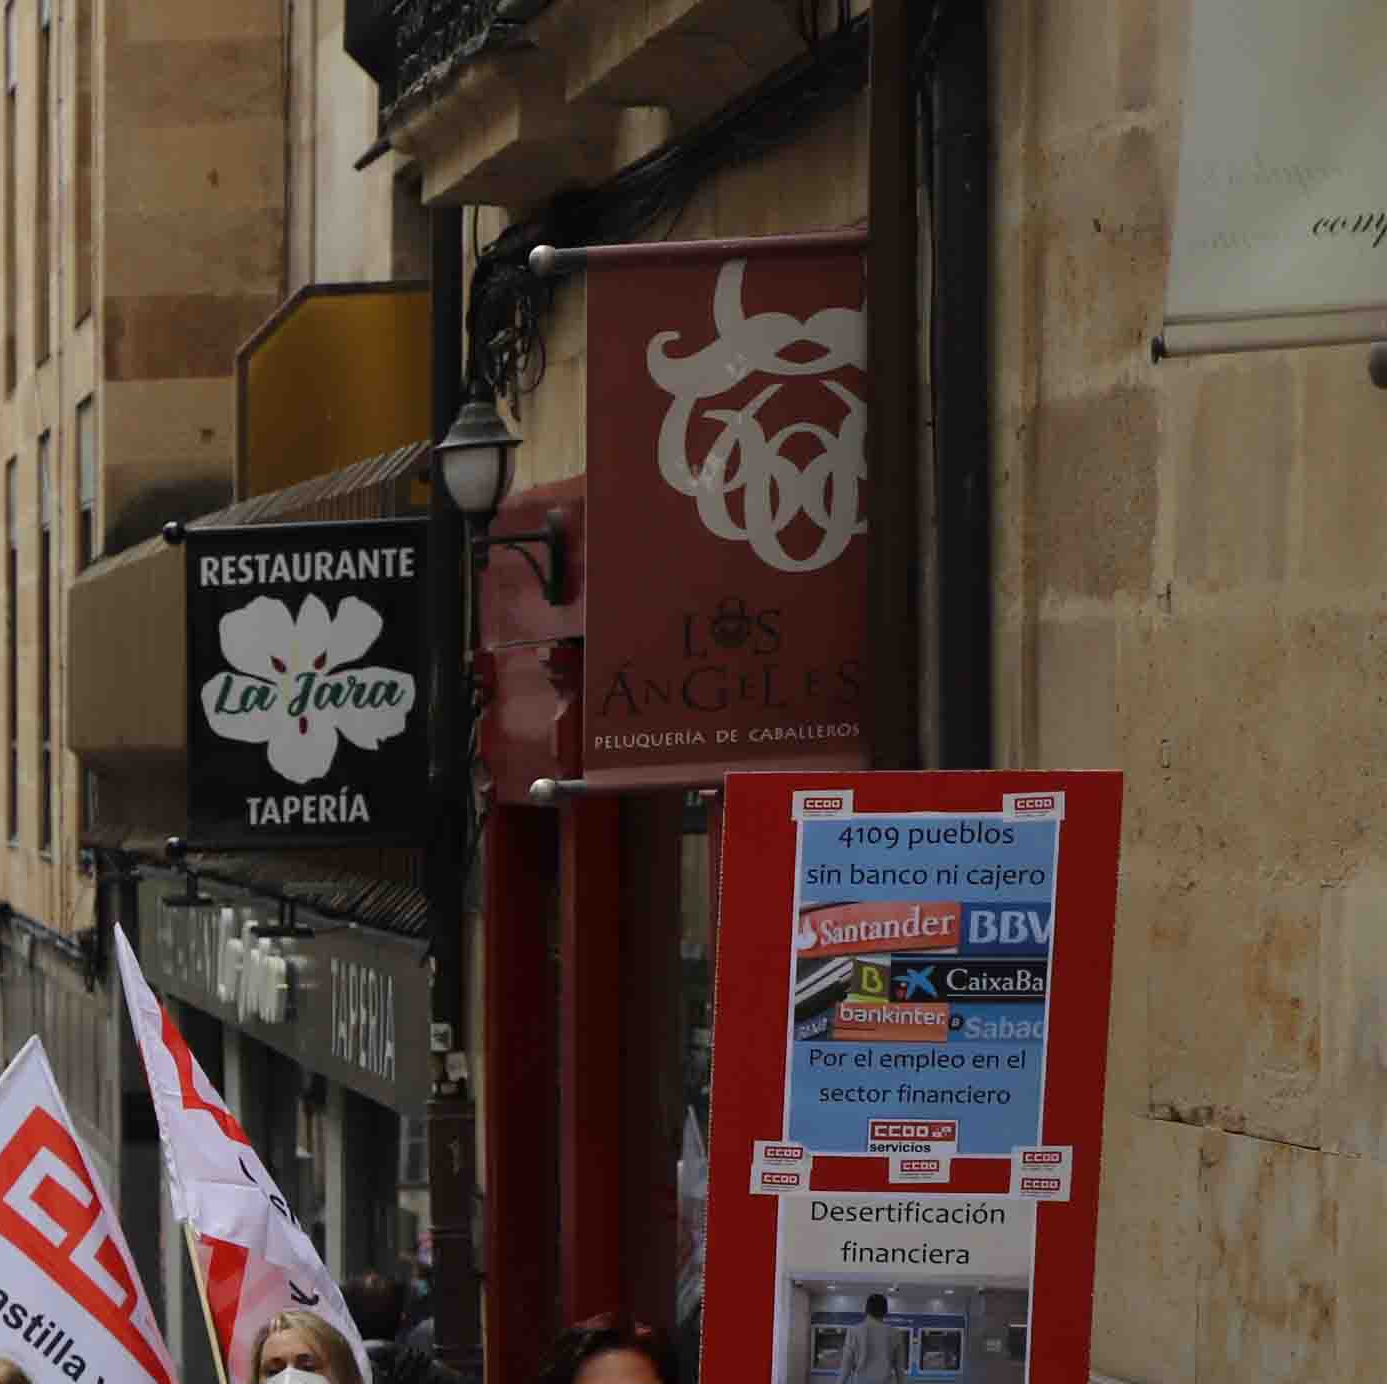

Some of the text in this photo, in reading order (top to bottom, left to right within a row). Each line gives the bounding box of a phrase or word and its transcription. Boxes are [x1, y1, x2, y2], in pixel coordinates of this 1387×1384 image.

[200, 548, 415, 586] RESTAURANTE
[214, 671, 406, 717] La Jara
[594, 722, 861, 750] PELUQUERÍA DE CABALLEROS
[246, 786, 370, 826] TAPERÍA
[804, 798, 842, 809] CCOO
[1015, 797, 1054, 809] CCOO
[838, 821, 1015, 850] 4109 pueblos
[806, 864, 1046, 890] sin banco ni cajero
[820, 905, 956, 946] Santander
[946, 968, 1045, 993] CaixaBa
[809, 1048, 1026, 1073] Por el empleo en el
[818, 1083, 1012, 1105] sector financiero
[874, 1125, 929, 1138] CCOO
[764, 1147, 802, 1158] CCOO
[869, 1142, 932, 1153] servicios
[1024, 1152, 1061, 1163] CCOO
[901, 1160, 939, 1171] CCOO
[762, 1173, 799, 1185] CCOO
[1022, 1178, 1059, 1190] CCOO
[810, 1200, 1006, 1225] Desertificación
[840, 1240, 971, 1265] financiera
